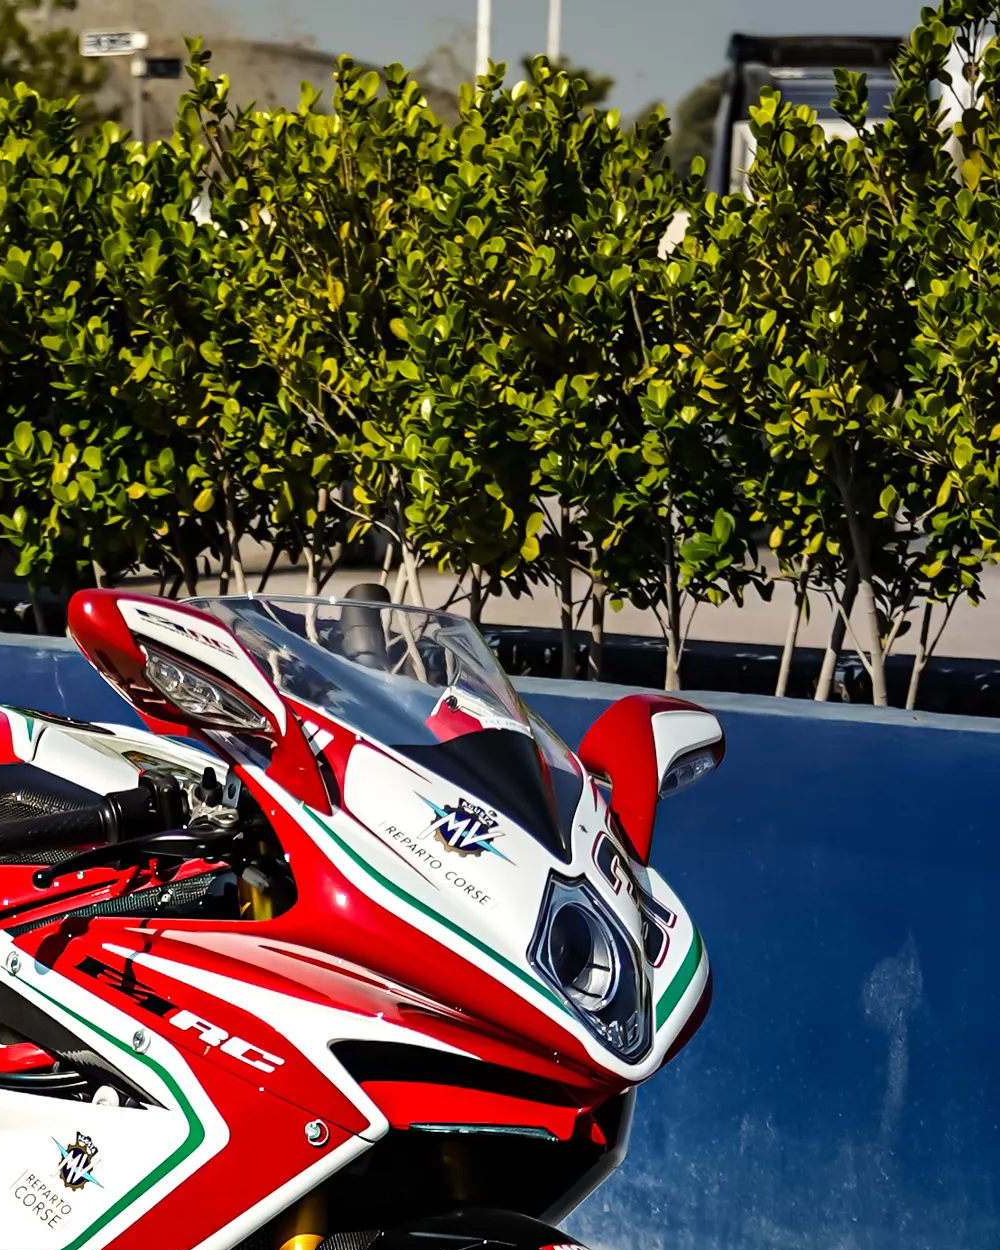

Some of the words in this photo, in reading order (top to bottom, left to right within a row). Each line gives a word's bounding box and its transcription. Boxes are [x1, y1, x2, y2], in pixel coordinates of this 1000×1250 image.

[416, 811, 506, 849] MV
[385, 825, 443, 870] REPARTO
[444, 870, 492, 906] CORSE
[14, 1185, 63, 1230] CORSE
[25, 1173, 72, 1215] REPARTO
